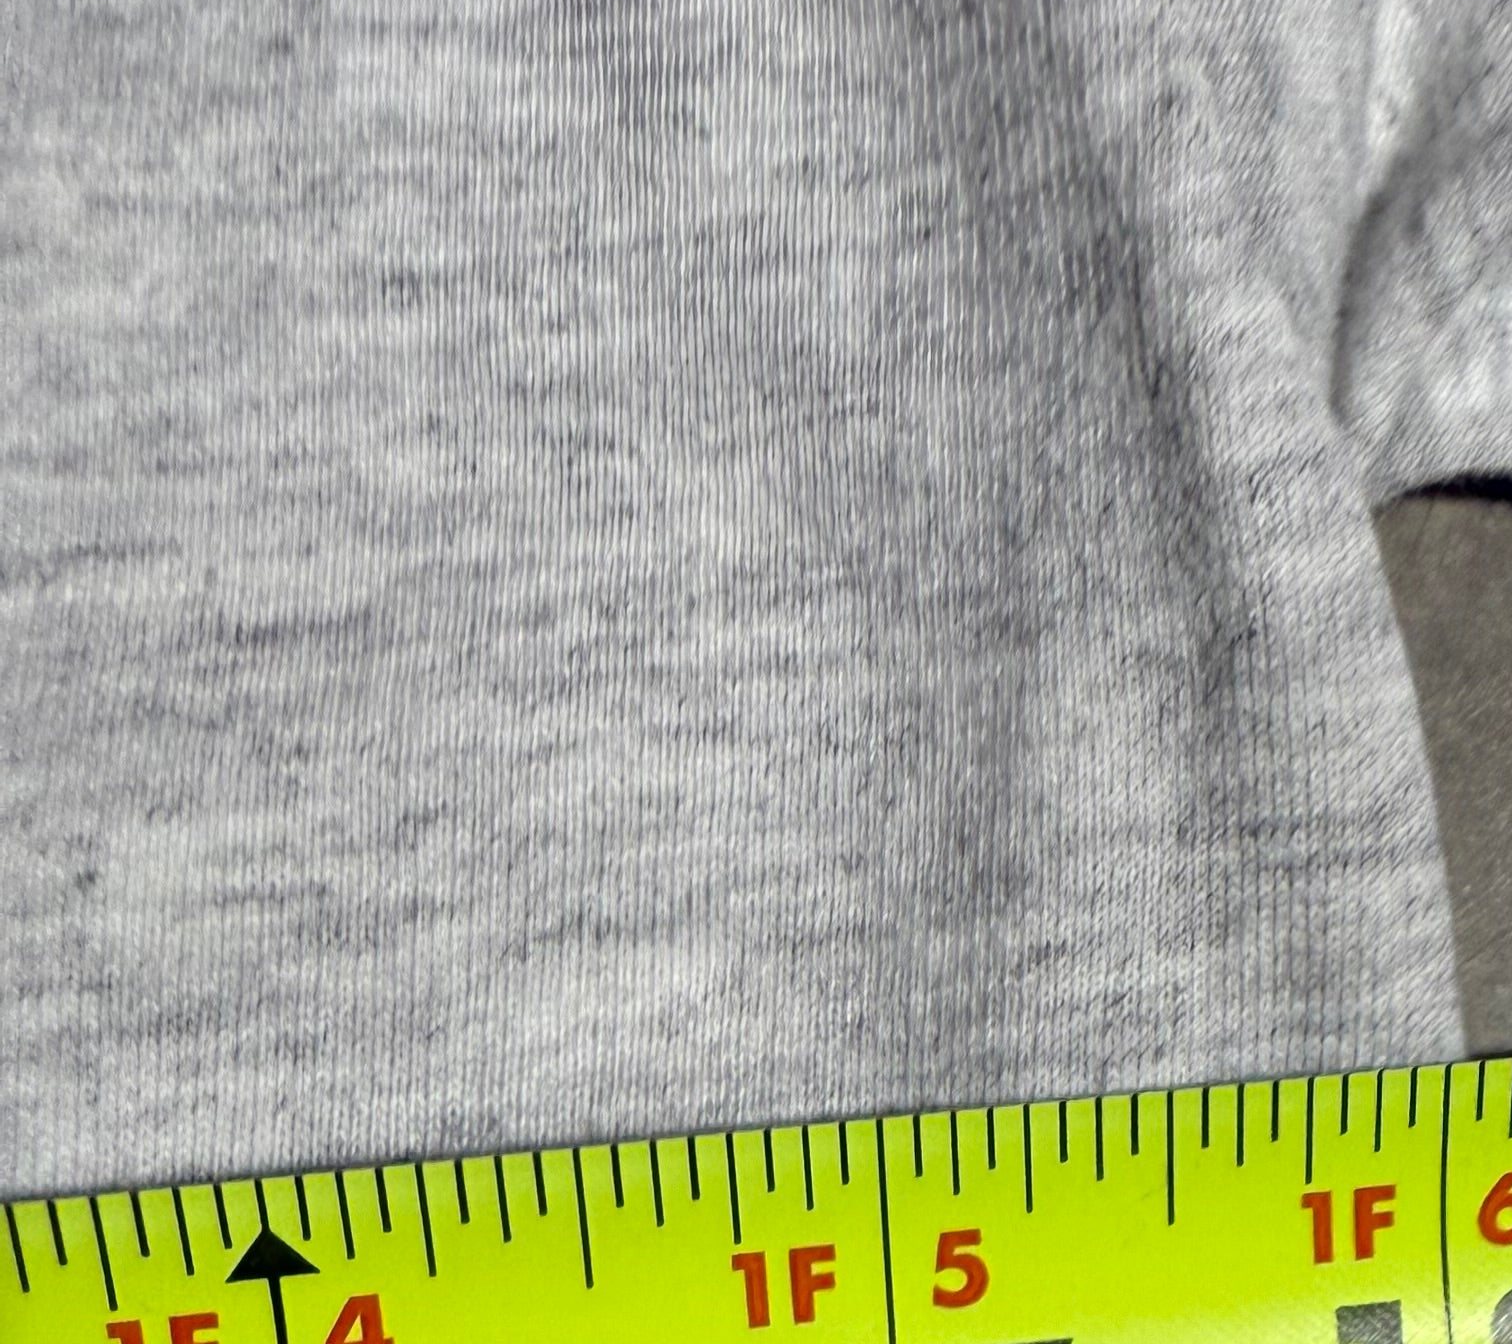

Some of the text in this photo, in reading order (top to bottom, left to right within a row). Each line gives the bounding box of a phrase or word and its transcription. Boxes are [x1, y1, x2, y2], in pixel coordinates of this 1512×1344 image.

[1300, 1183, 1396, 1264] 1F
[730, 1228, 990, 1329] 1F 5
